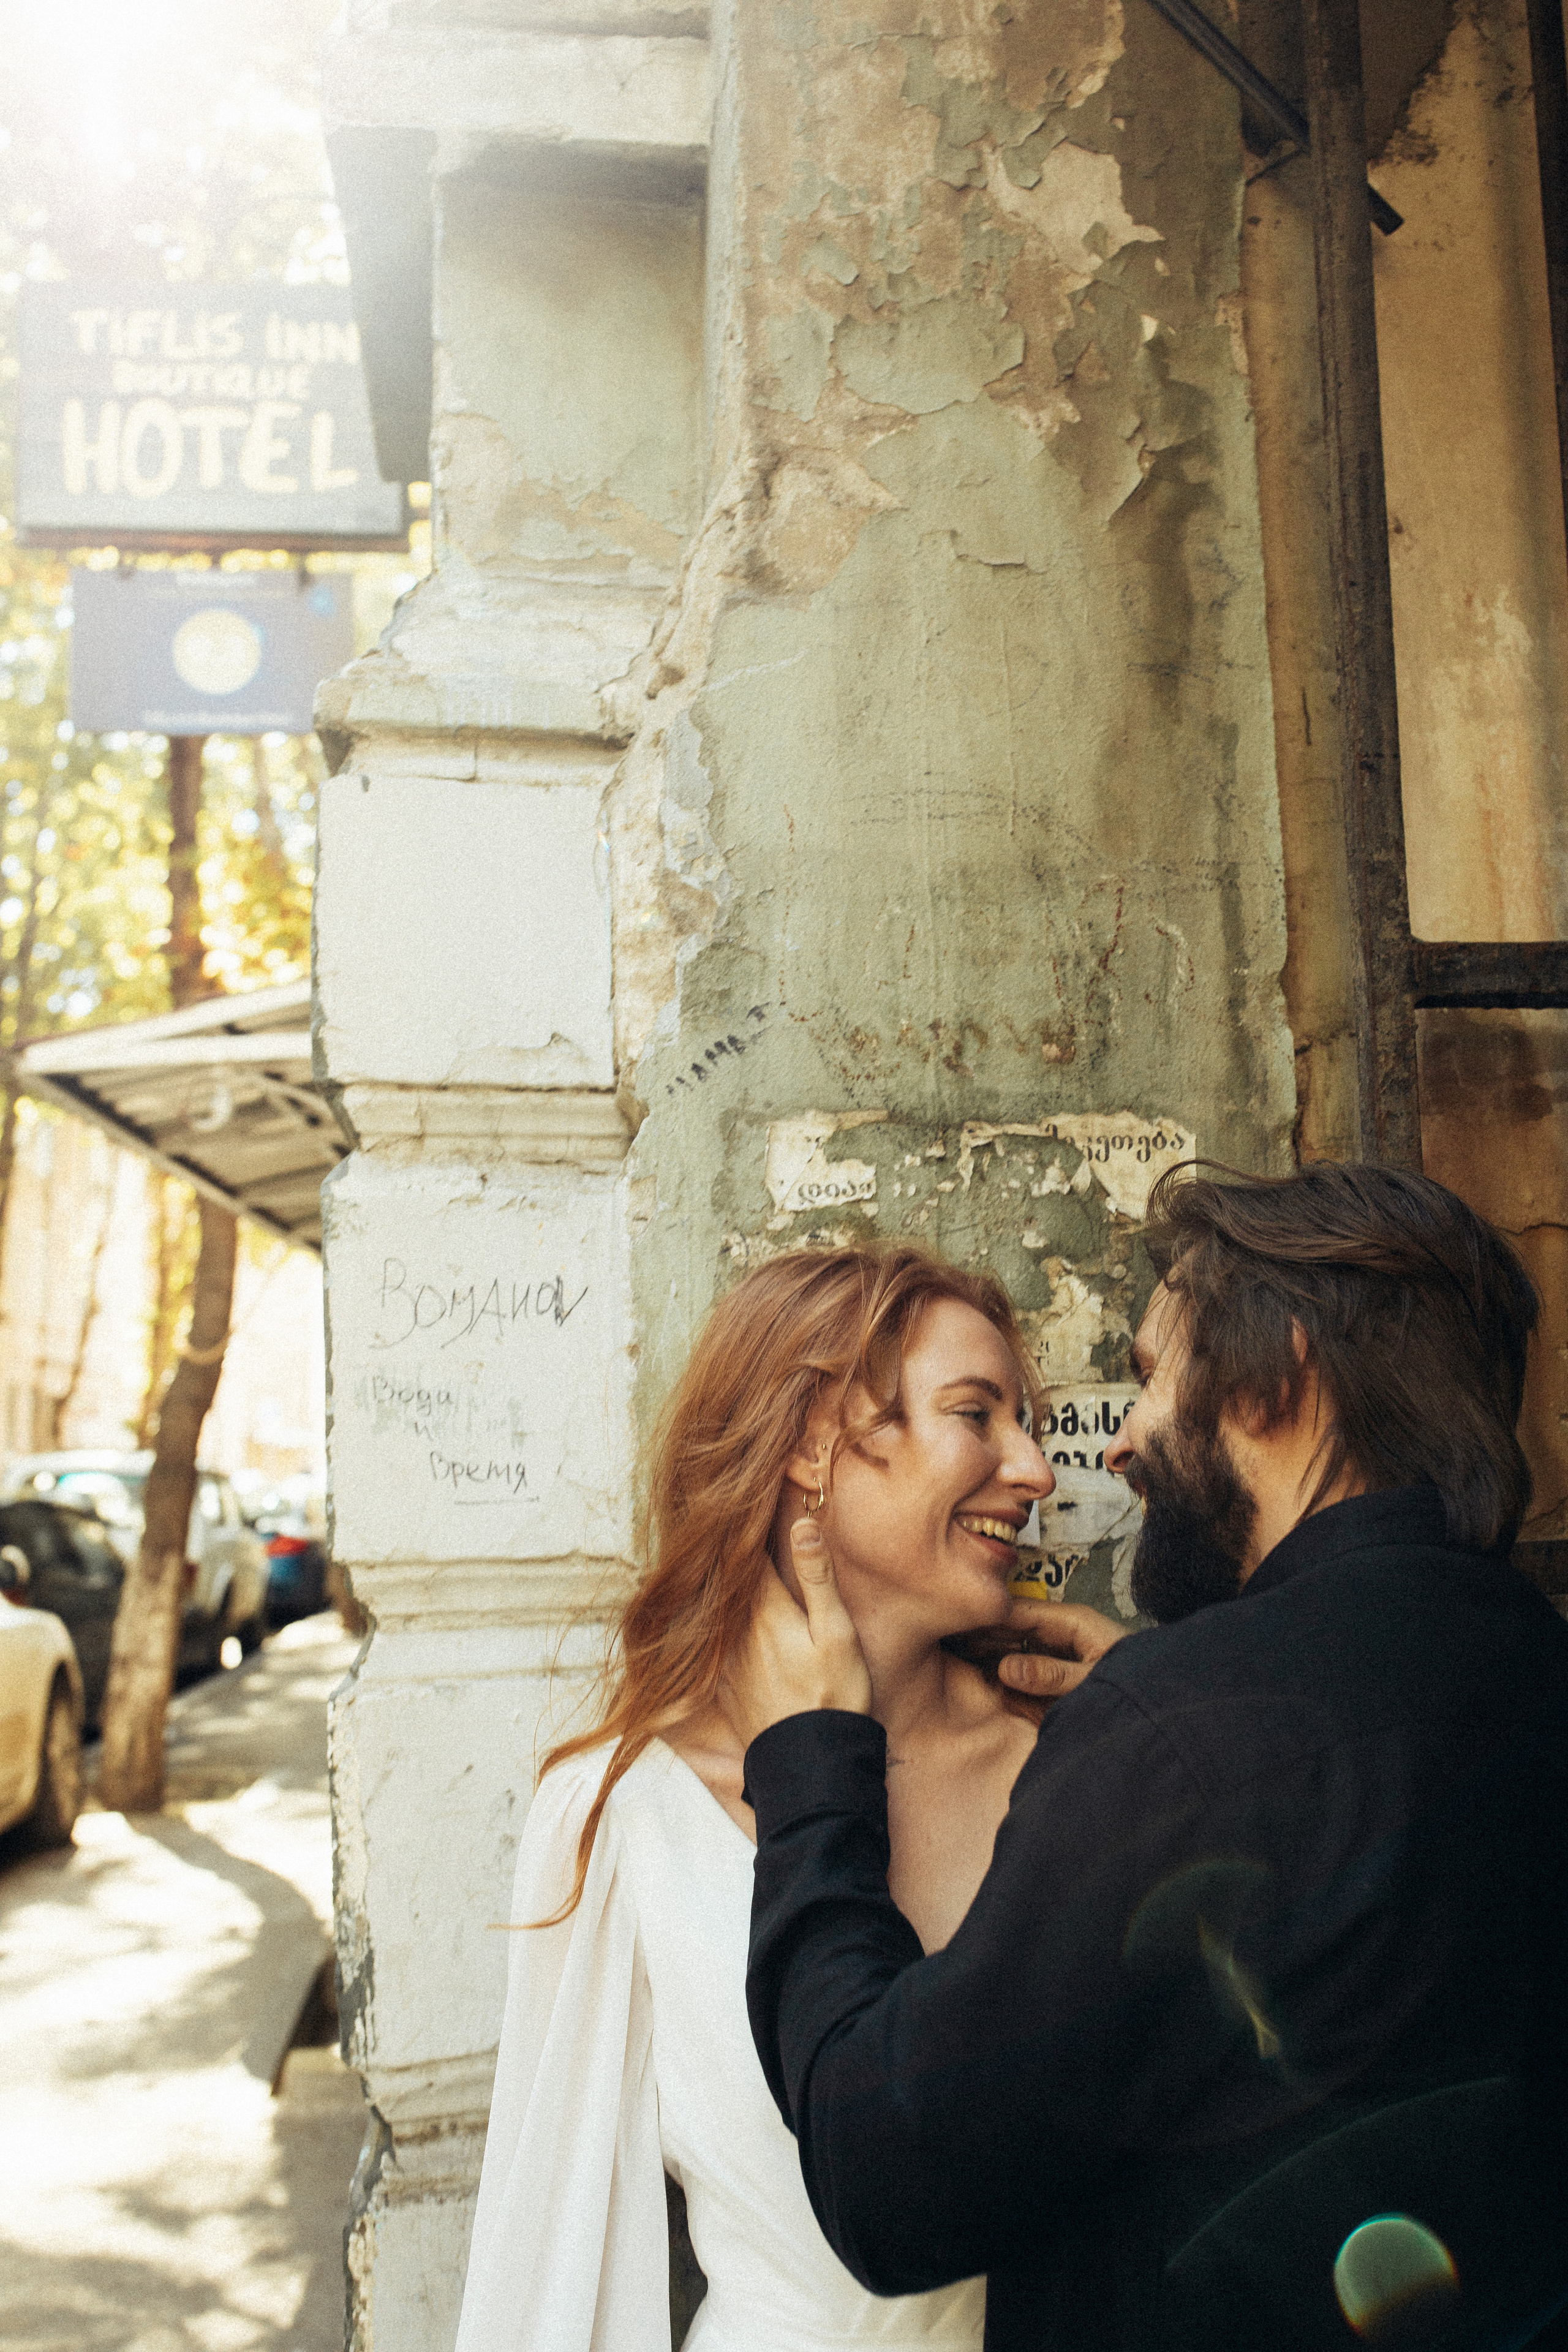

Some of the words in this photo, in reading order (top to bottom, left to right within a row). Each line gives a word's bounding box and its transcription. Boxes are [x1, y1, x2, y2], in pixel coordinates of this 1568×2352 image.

[69, 307, 244, 359] TIFLIS
[265, 311, 362, 364] INN
[62, 397, 360, 499] HOTEL
